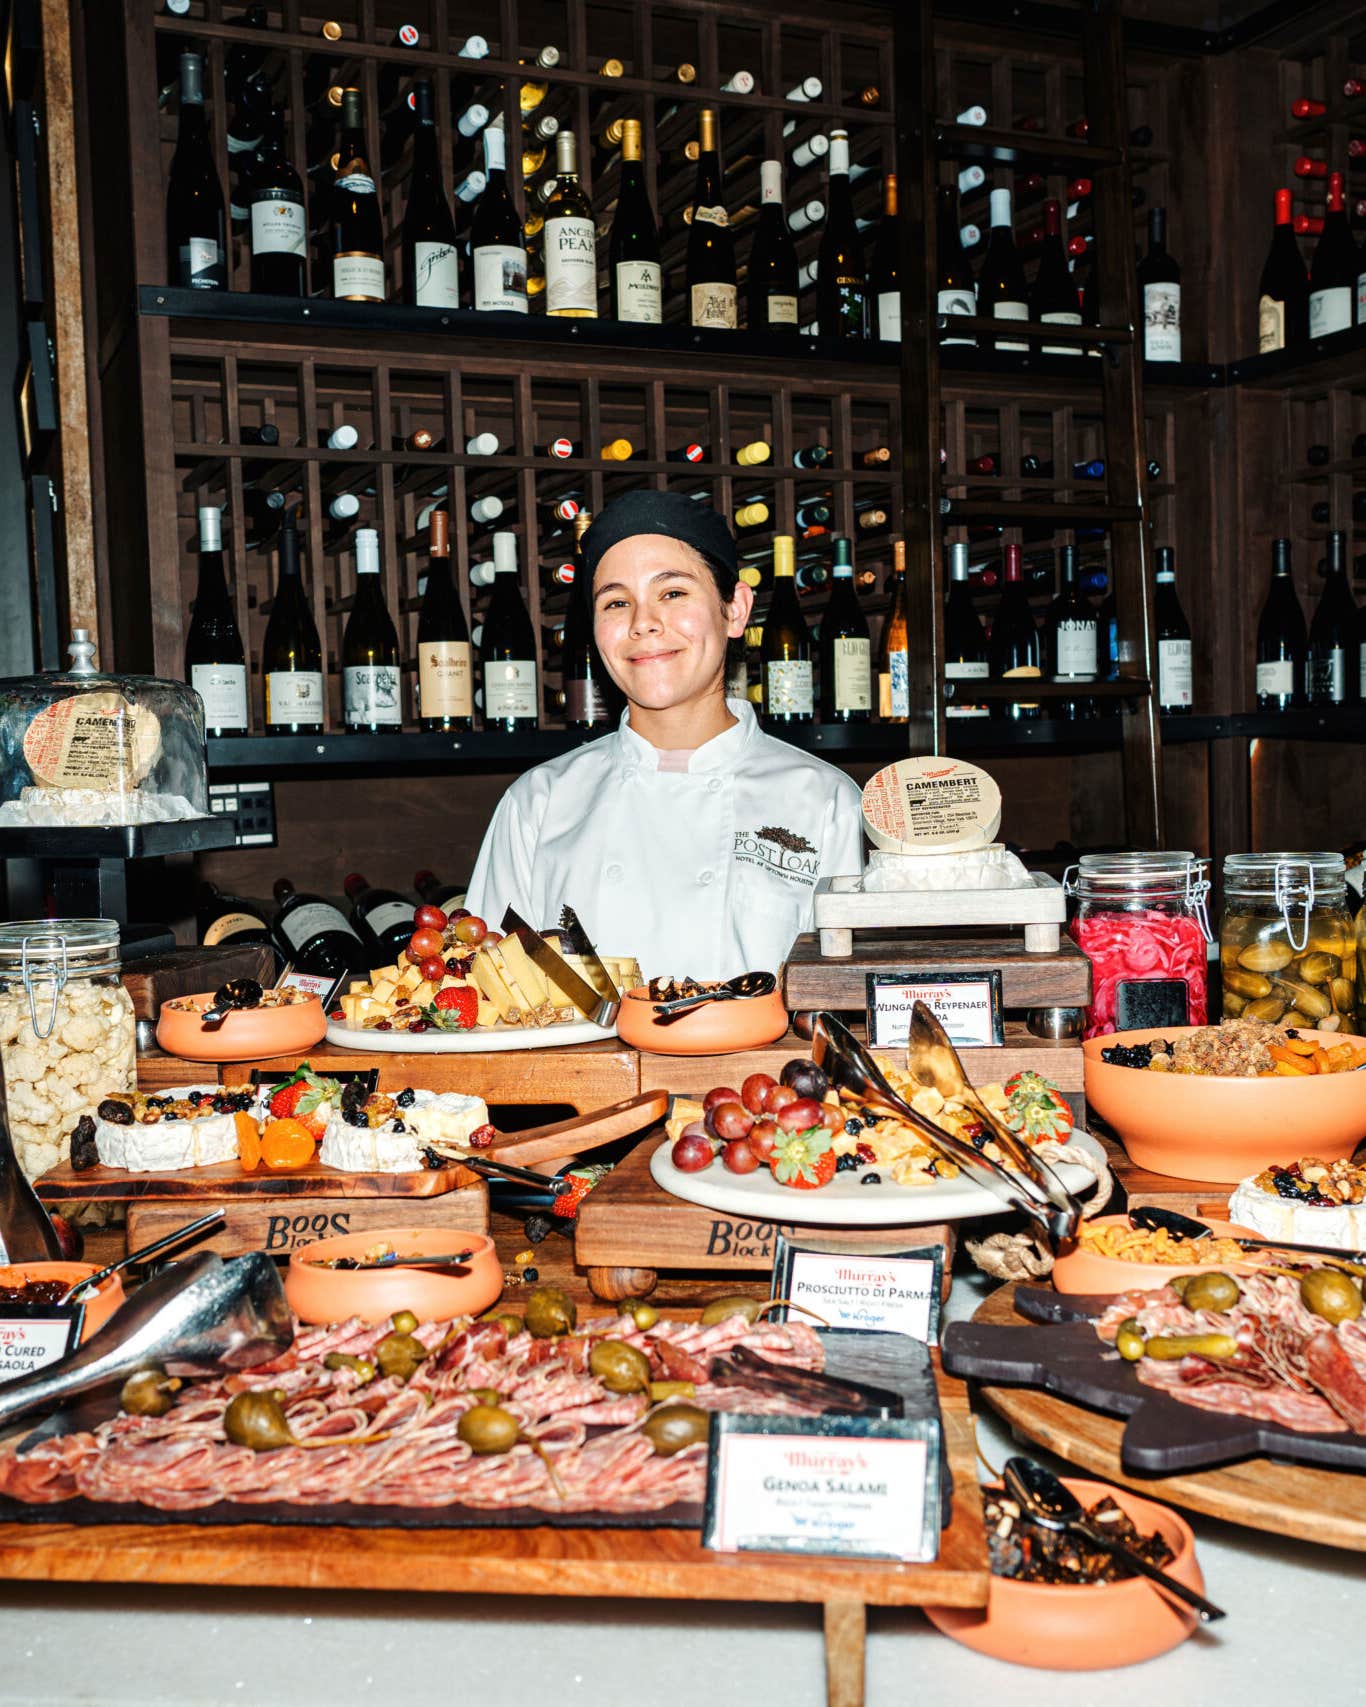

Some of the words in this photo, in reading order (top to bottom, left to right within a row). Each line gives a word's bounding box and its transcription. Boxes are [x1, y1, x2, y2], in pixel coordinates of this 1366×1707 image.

[906, 777, 977, 791] CAMEMBERT
[734, 838, 777, 861] POST
[787, 855, 820, 876] OAK
[735, 855, 755, 864] HOTEL
[765, 866, 788, 879] UPTOWN
[902, 989, 952, 1001] Murray's
[934, 1001, 988, 1011] REYPENAER
[835, 1268, 897, 1287] Murray's
[796, 1281, 870, 1297] PROSCIUTTO
[872, 1287, 885, 1298] DI
[888, 1288, 934, 1301] PARMA
[5, 1345, 45, 1356] CURED
[784, 1453, 868, 1473] Murray's
[763, 1476, 820, 1492] GENOA
